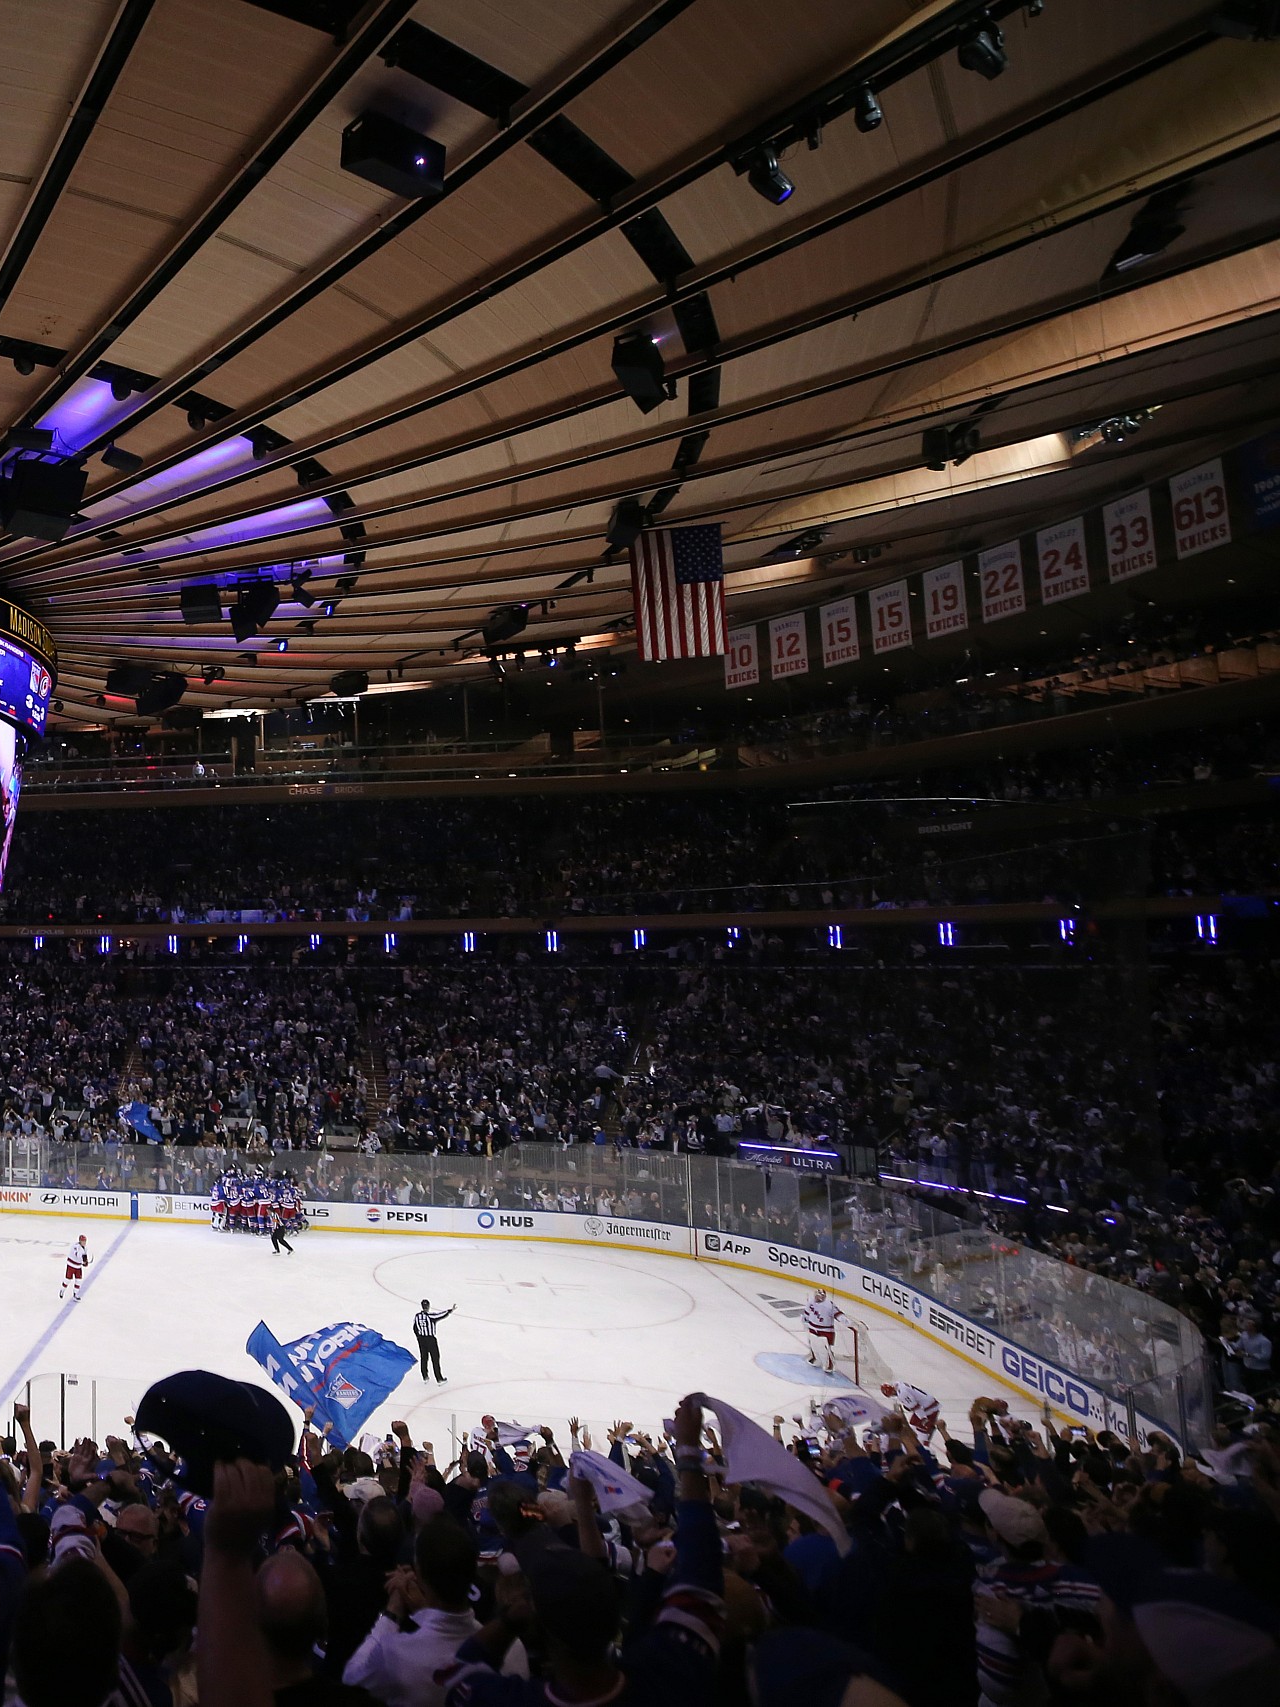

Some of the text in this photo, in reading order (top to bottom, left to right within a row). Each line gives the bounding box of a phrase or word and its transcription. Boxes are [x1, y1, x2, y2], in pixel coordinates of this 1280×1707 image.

[1174, 485, 1225, 531] 613
[1110, 516, 1149, 555] 33
[1179, 523, 1226, 552] KNICKS
[1042, 541, 1083, 580] 24
[1111, 550, 1154, 577] KNICKS
[984, 563, 1018, 599] 22
[1044, 575, 1087, 599] KNICKS
[931, 584, 958, 616] 19
[985, 595, 1023, 618] KNICKS
[9, 606, 42, 645] MADISON
[877, 601, 903, 631] 15
[928, 613, 966, 633] KNICKS
[827, 618, 852, 646] 15
[875, 630, 910, 649] KNICKS
[731, 644, 752, 670] 10
[776, 633, 801, 659] 12
[825, 645, 857, 662] KNICKS
[727, 669, 758, 685] KNICKS
[773, 658, 806, 675] KNICKS
[288, 786, 364, 795] CHASE BRIDGE
[792, 1157, 835, 1171] ULTRA
[63, 1195, 119, 1207] HYUNDAI
[174, 1202, 211, 1211] BETMG
[386, 1211, 428, 1223] PEPSI
[500, 1214, 534, 1228] HUB
[768, 1246, 842, 1280] Spectrum
[862, 1275, 910, 1310] CHASE
[929, 1307, 996, 1359] ESPN BET
[1002, 1346, 1090, 1417] GEICO
